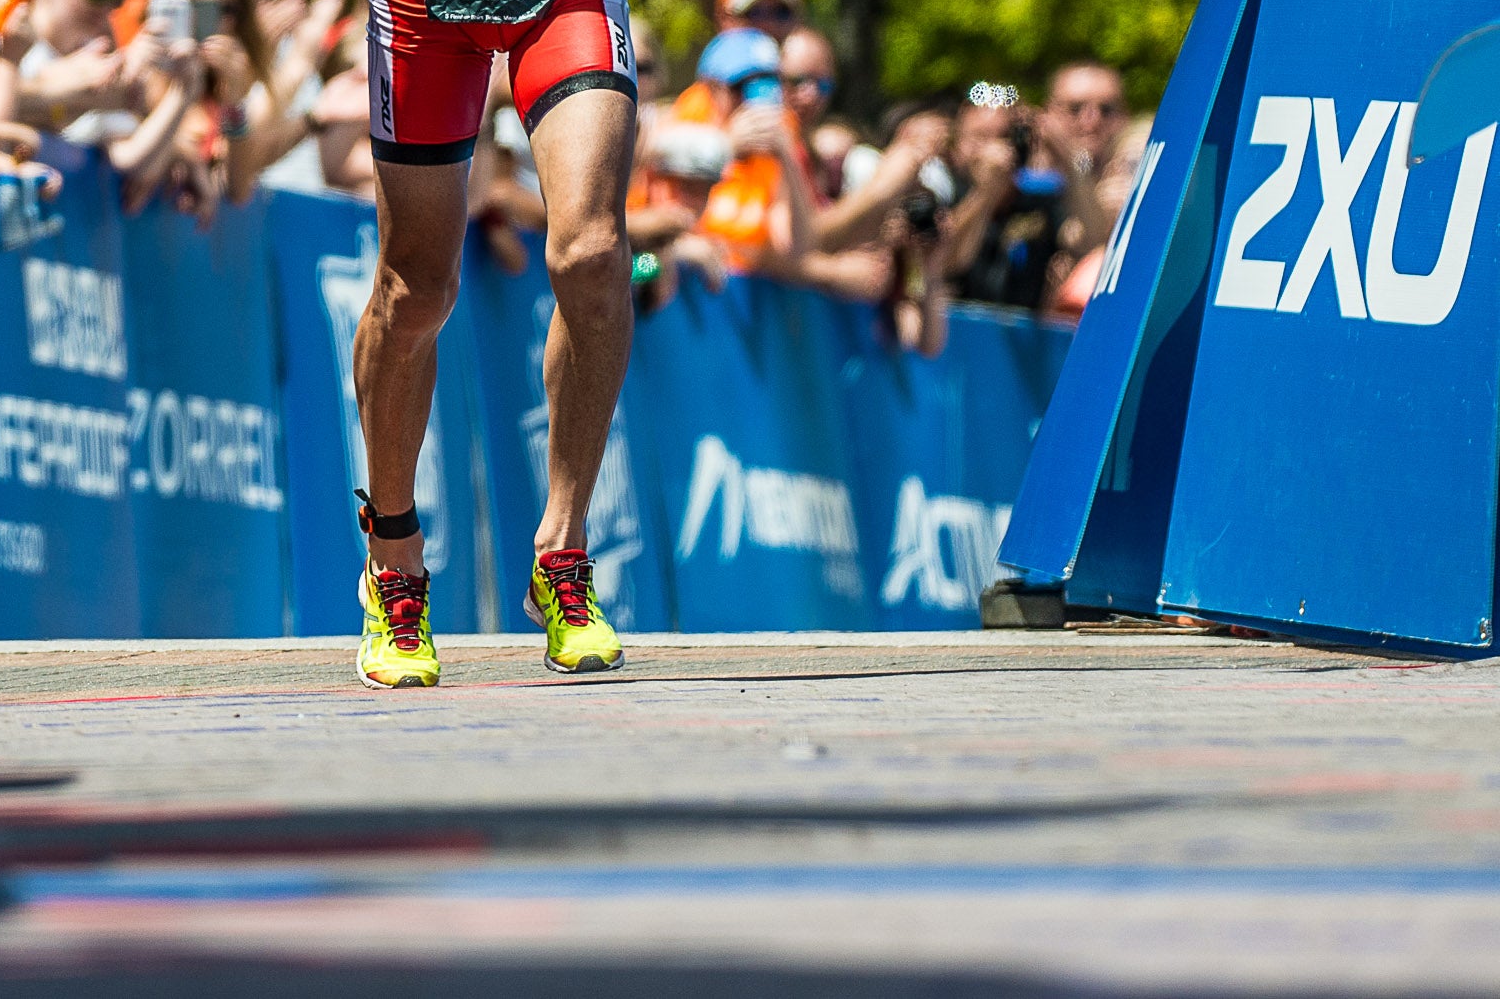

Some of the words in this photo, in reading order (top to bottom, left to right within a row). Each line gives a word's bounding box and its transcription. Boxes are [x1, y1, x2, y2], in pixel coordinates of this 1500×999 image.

[614, 20, 628, 70] 2XU
[380, 75, 392, 135] 2XU
[1214, 95, 1498, 326] 2XU
